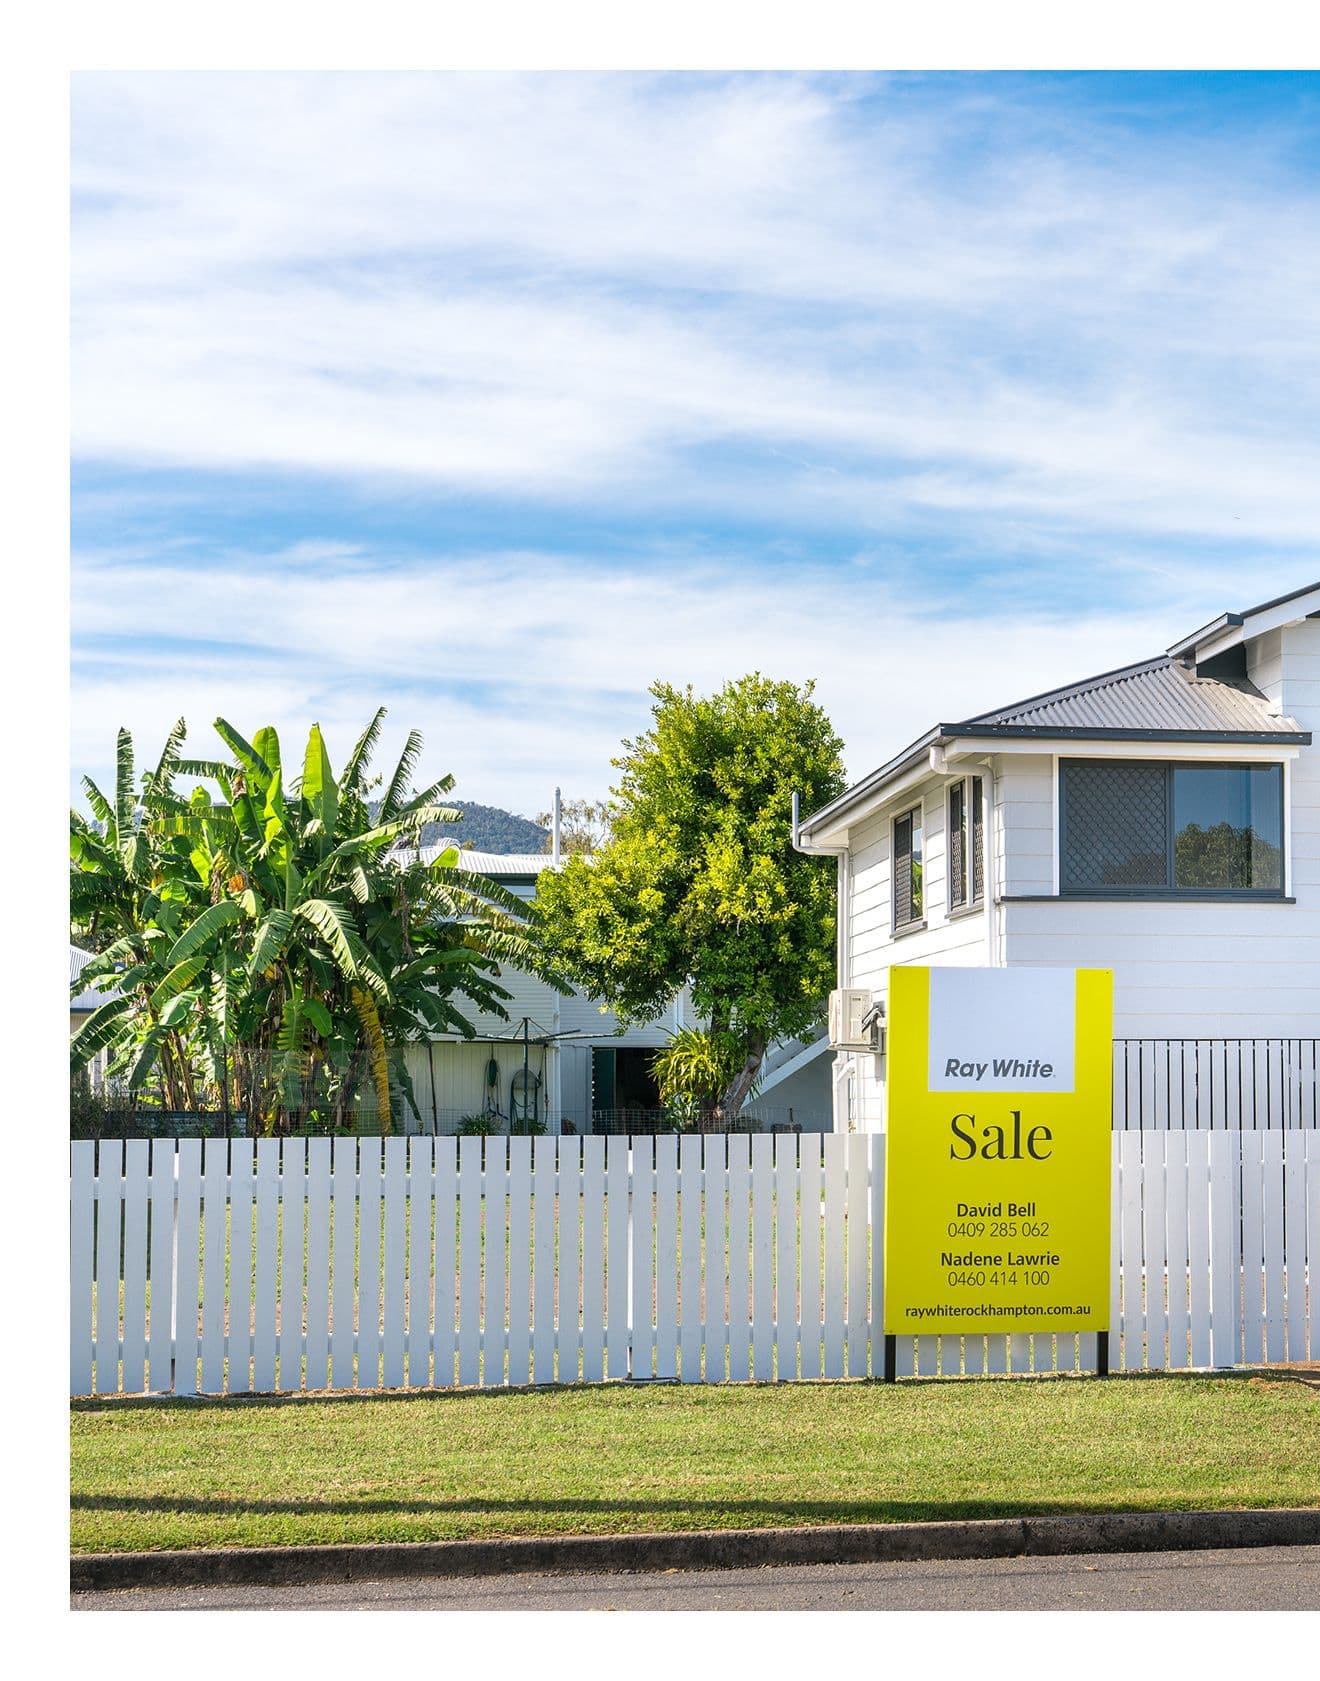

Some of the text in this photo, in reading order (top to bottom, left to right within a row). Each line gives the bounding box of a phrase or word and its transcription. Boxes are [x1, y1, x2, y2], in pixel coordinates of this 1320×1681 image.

[945, 1058, 1053, 1081] Ray White
[949, 1110, 1053, 1161] Sale
[957, 1202, 1036, 1218] David Bell
[948, 1222, 1049, 1237] 0409 285 062
[940, 1251, 1060, 1266] Nadene Lawrie
[948, 1271, 1050, 1286] 0460 414 100
[905, 1303, 1090, 1317] raywhiterockhampton.com.au
